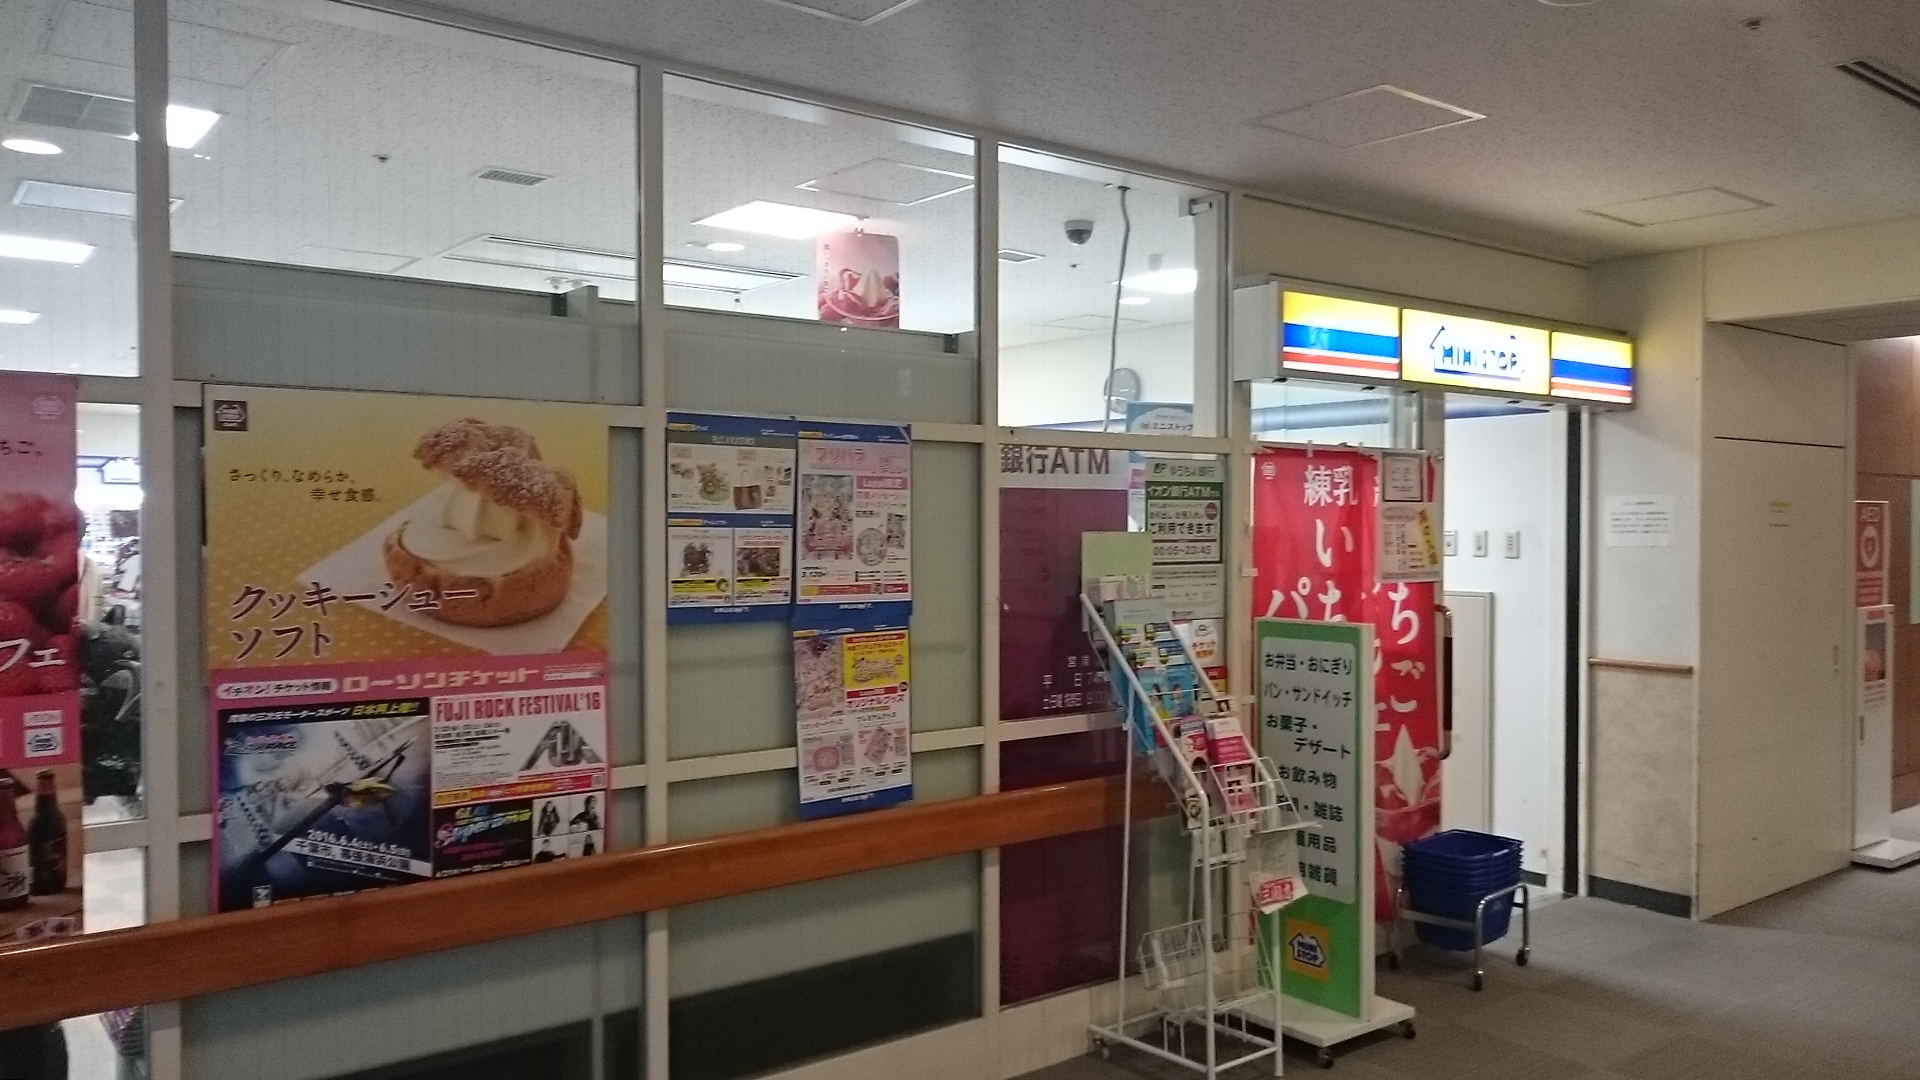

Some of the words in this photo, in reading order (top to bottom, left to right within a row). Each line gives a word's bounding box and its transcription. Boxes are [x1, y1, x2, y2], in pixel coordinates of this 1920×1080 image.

[1001, 446, 1110, 475] 銀行ATM
[1303, 464, 1359, 507] 練乳
[230, 580, 477, 622] クッキーシュー
[231, 622, 332, 661] ソフト
[1265, 652, 1352, 676] お弁当・おにぎり
[342, 668, 540, 694] ローソンチケット
[1264, 682, 1352, 708] パン・サンドイッチ
[435, 701, 470, 722] FUJI
[474, 697, 515, 720] ROCK
[1266, 714, 1318, 734] お菓子・
[1294, 737, 1352, 759] デザート
[1278, 765, 1337, 789] お飲み物
